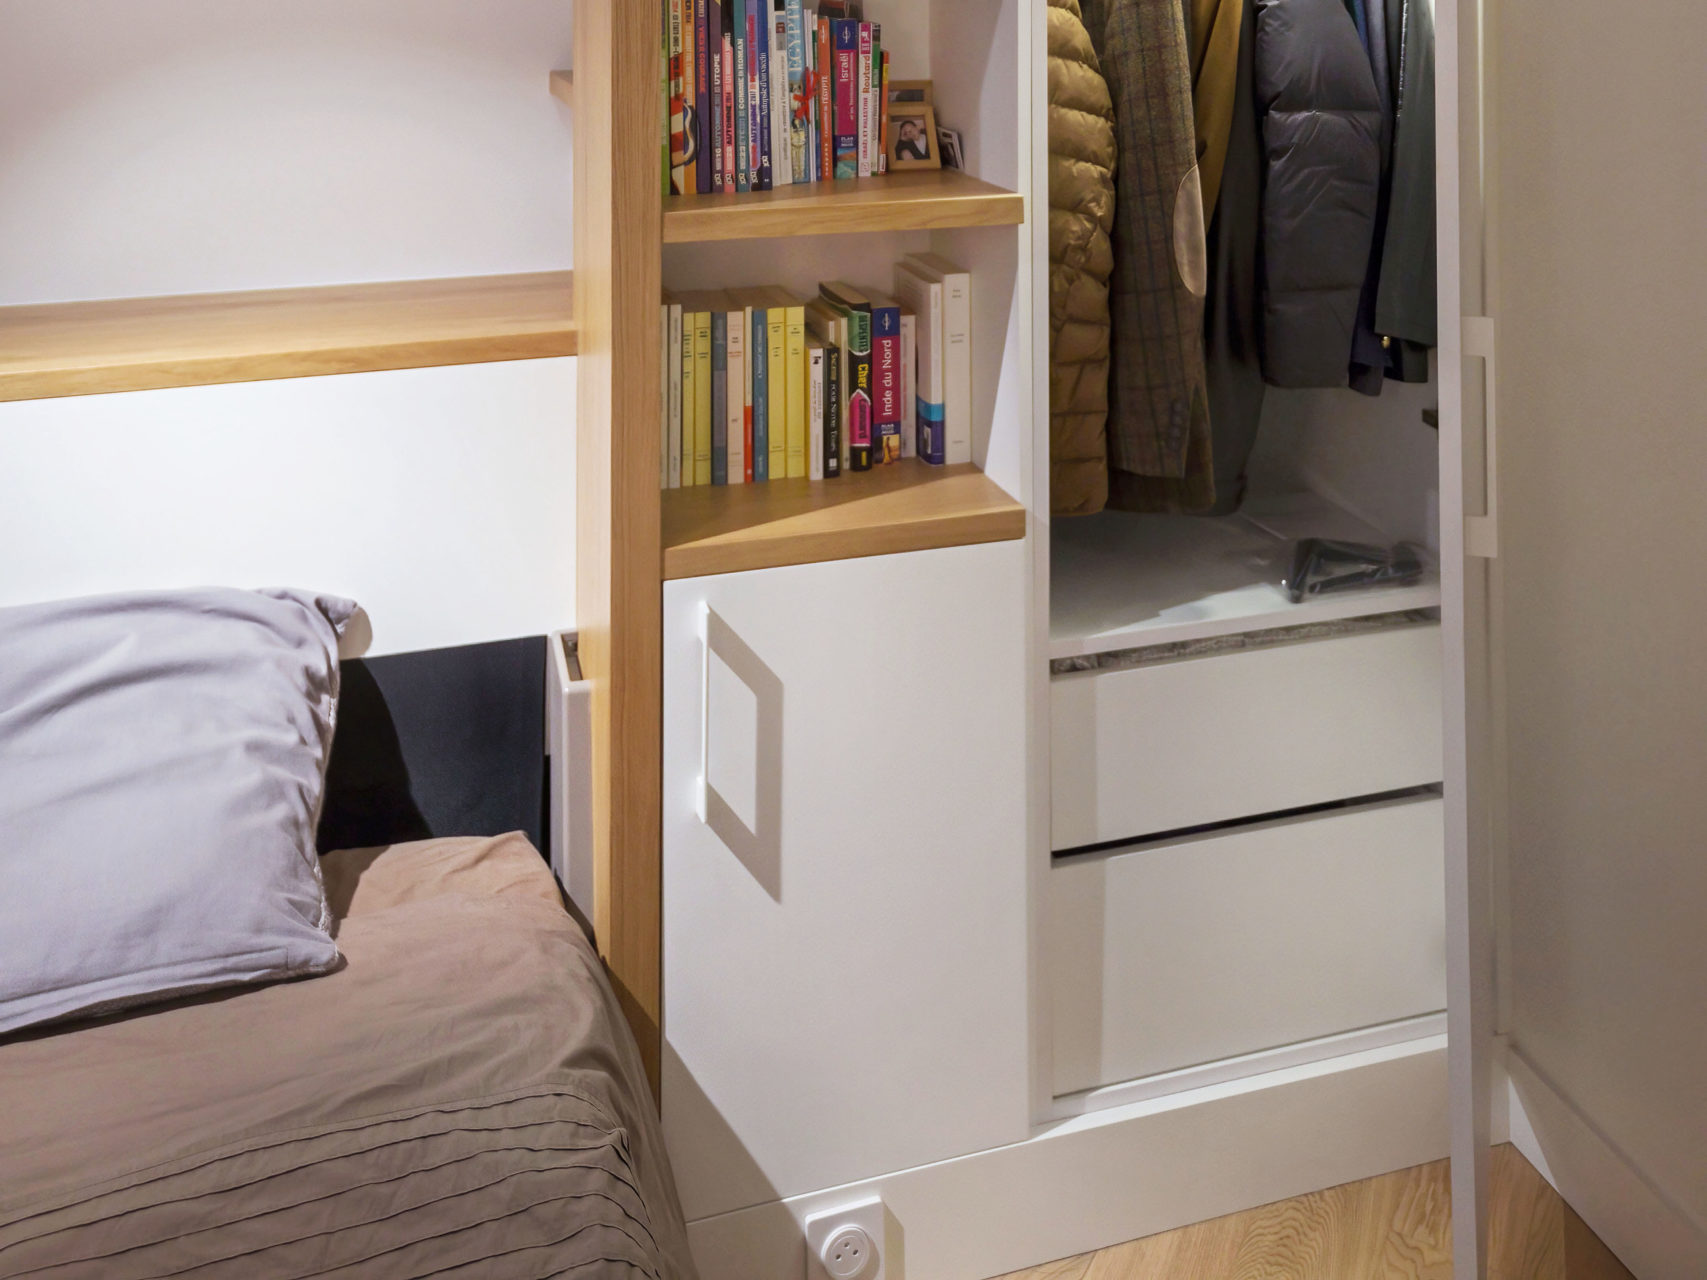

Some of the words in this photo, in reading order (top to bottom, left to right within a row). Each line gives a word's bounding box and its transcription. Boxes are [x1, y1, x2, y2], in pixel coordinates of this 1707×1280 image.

[736, 38, 744, 70] ROMAN
[838, 53, 849, 82] Israël
[861, 55, 870, 94] Routard
[760, 87, 769, 116] Autopsie
[881, 339, 892, 369] Nord
[857, 363, 868, 389] Cher
[881, 372, 892, 387] du
[882, 390, 893, 416] Inde
